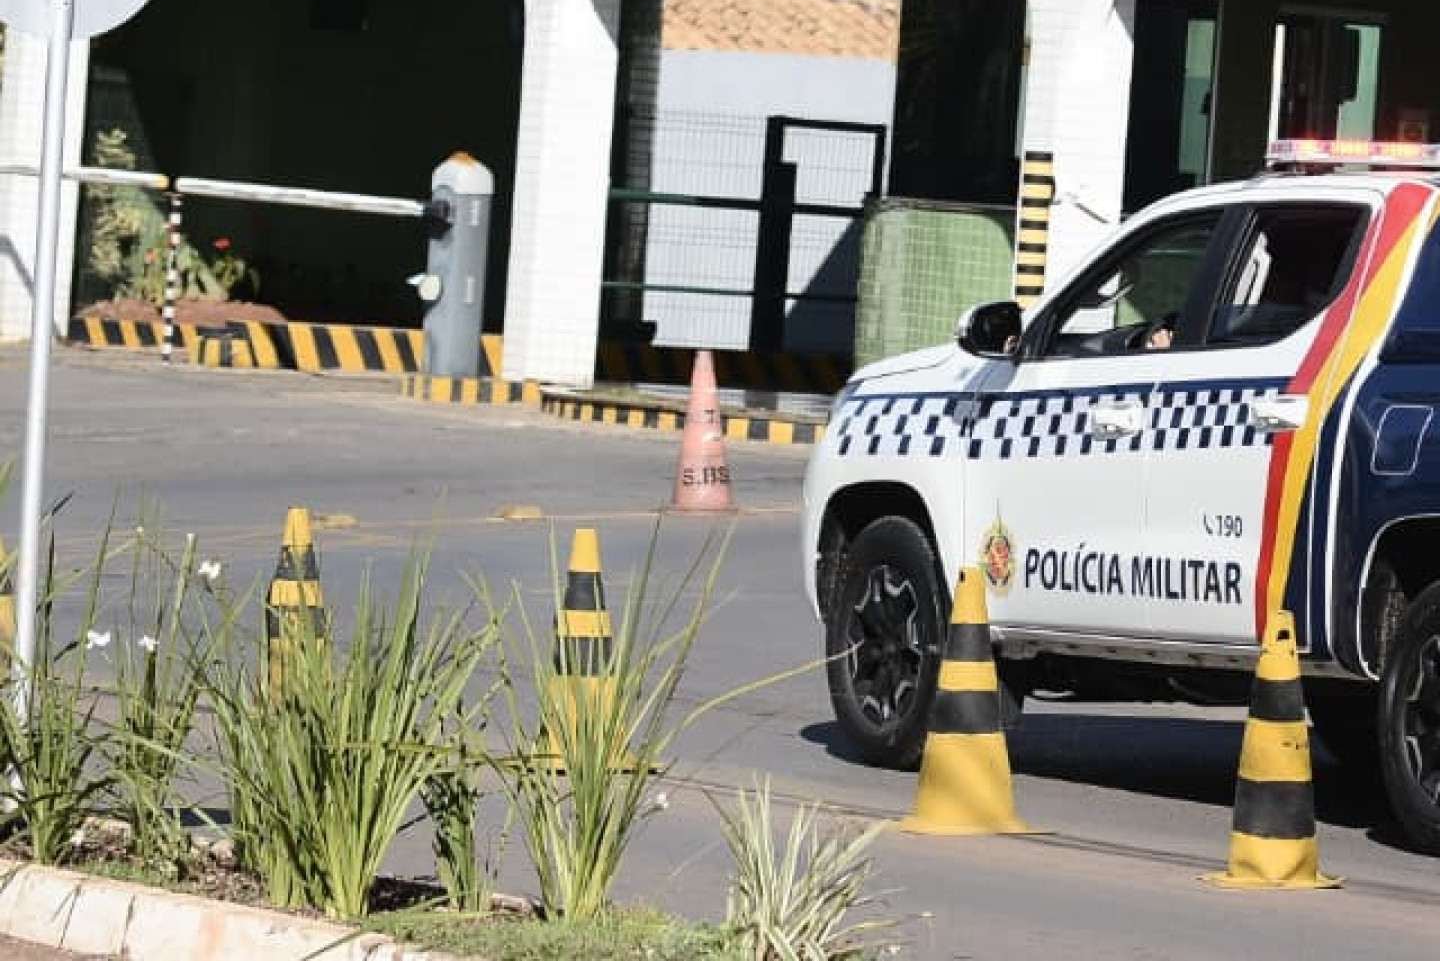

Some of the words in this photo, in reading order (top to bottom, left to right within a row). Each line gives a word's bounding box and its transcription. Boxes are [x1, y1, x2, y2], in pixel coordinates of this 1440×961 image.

[1215, 514, 1243, 538] 190
[1025, 542, 1124, 595] POLÍCIA
[1131, 555, 1243, 604] MILITAR
